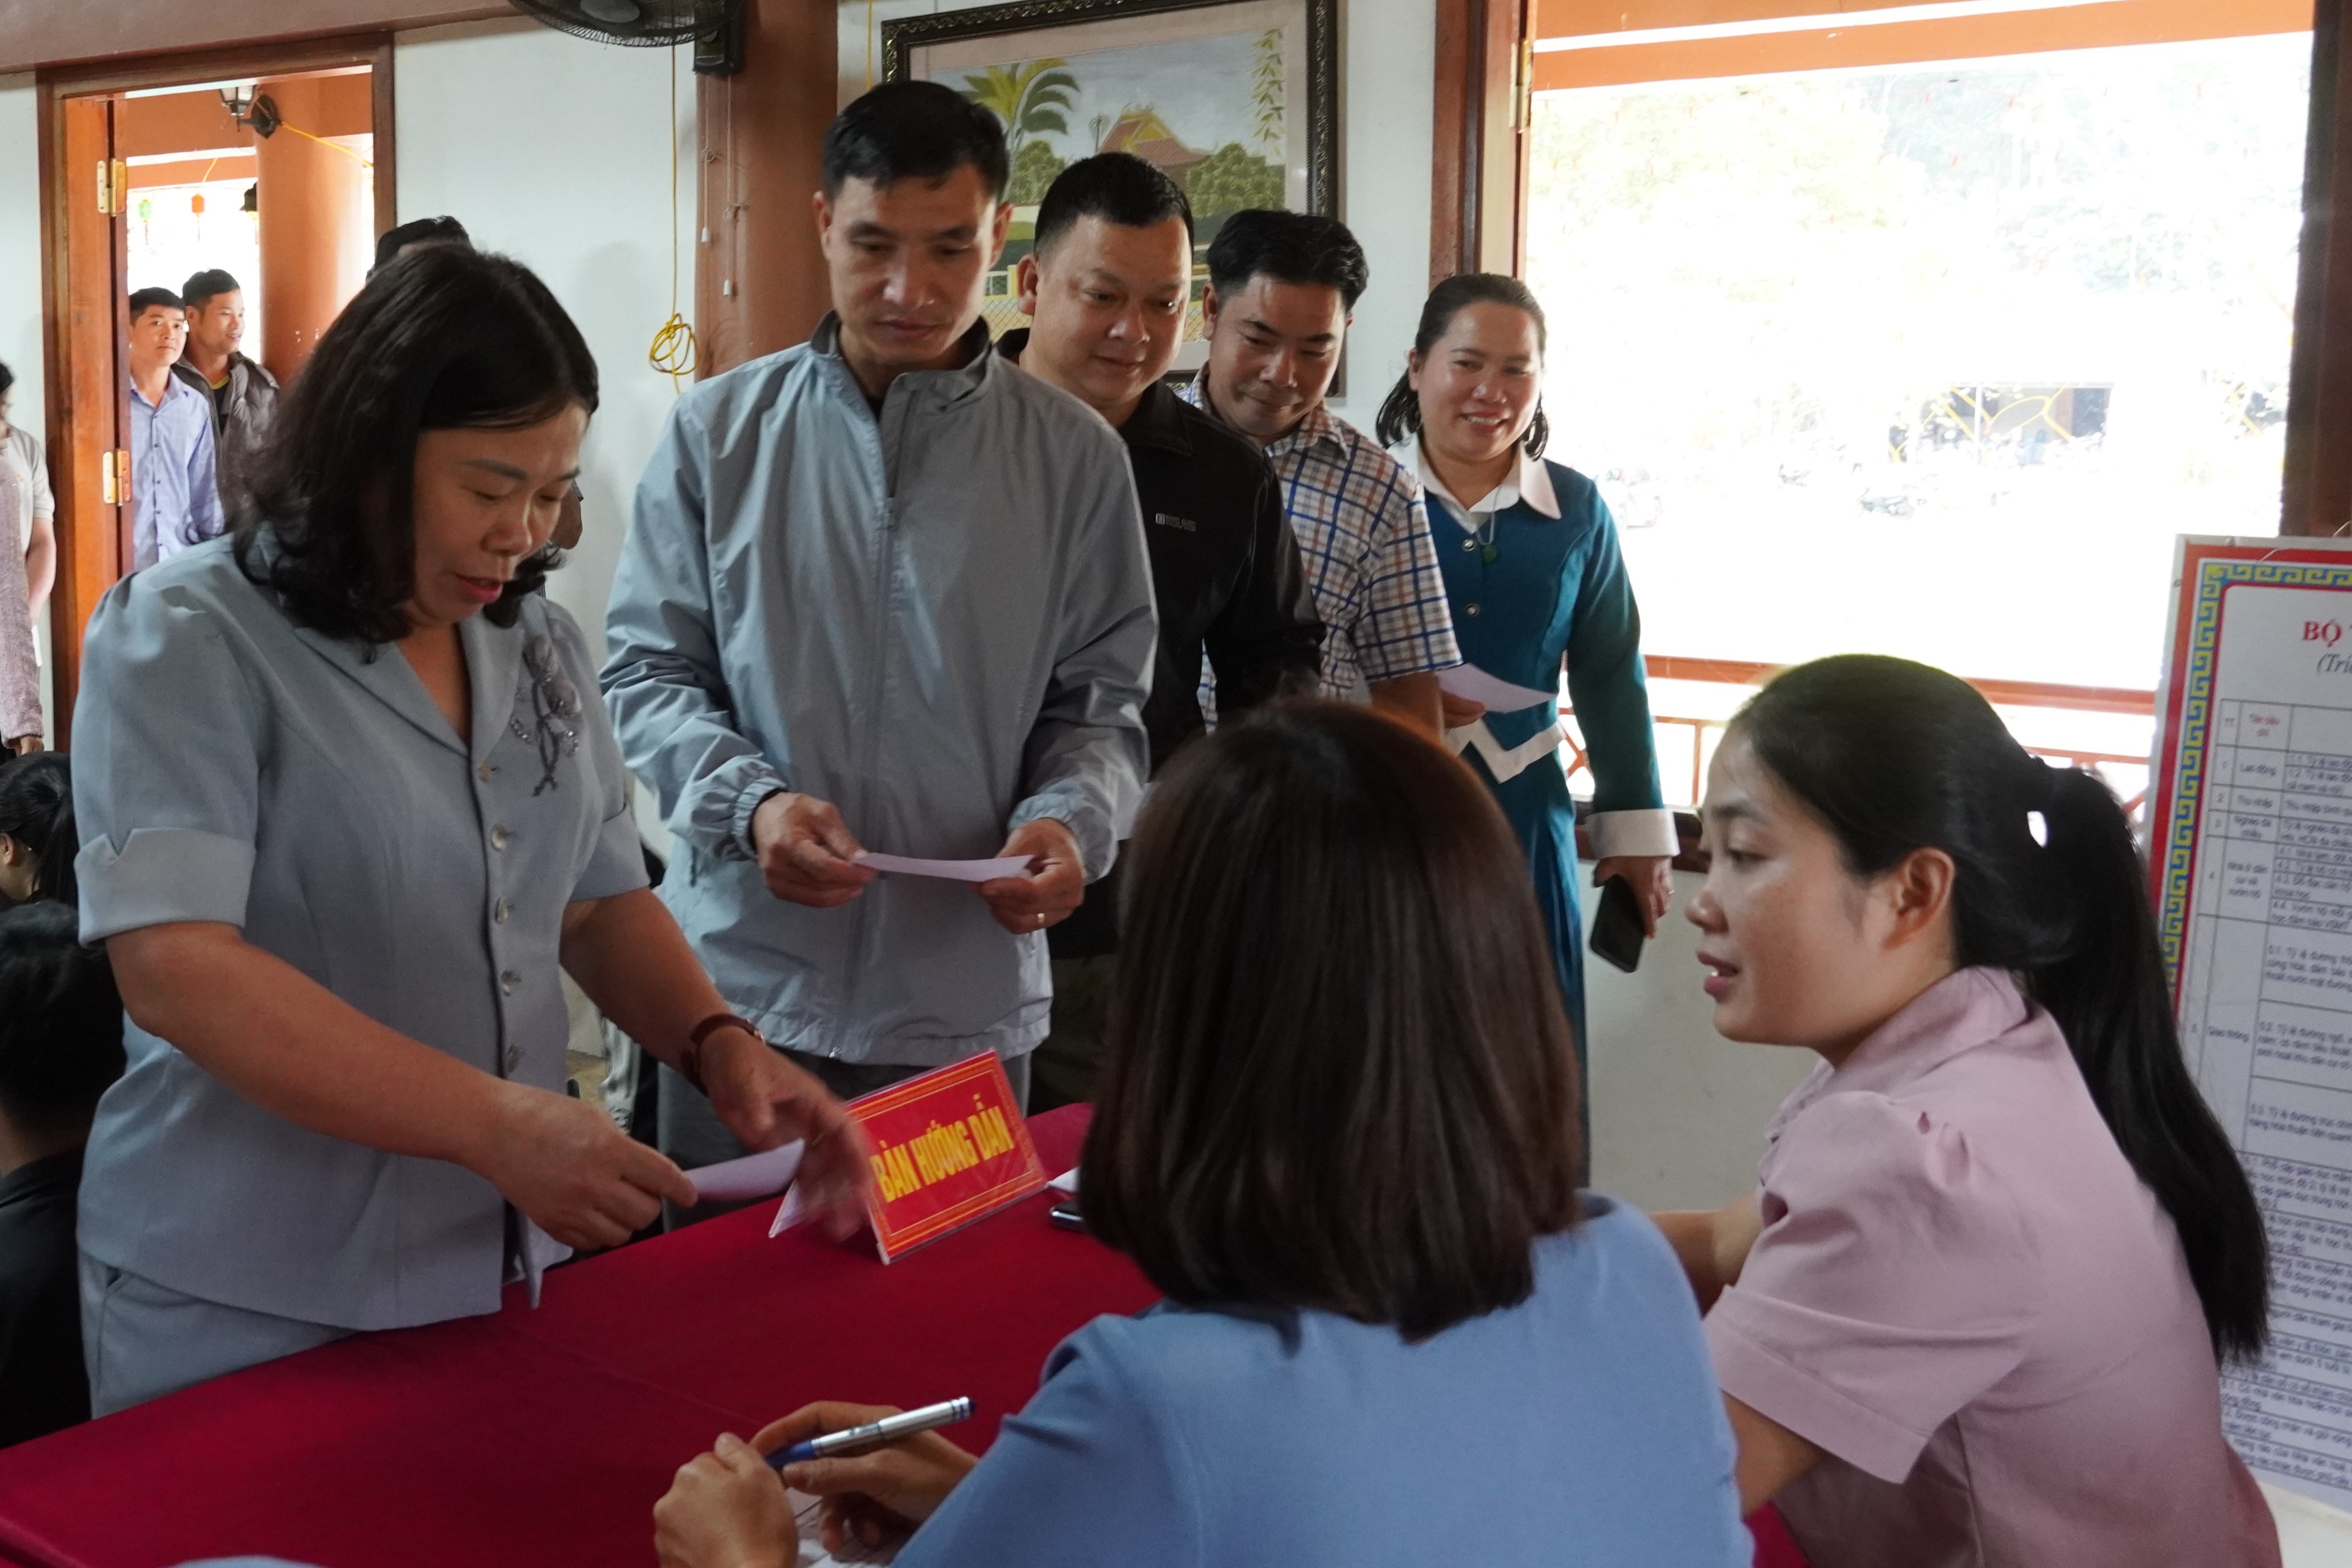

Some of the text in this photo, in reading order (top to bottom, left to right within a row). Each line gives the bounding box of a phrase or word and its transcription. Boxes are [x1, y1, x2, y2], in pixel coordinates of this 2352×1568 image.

[869, 1093, 1015, 1203] BÀN HƯỚNG DẪN
